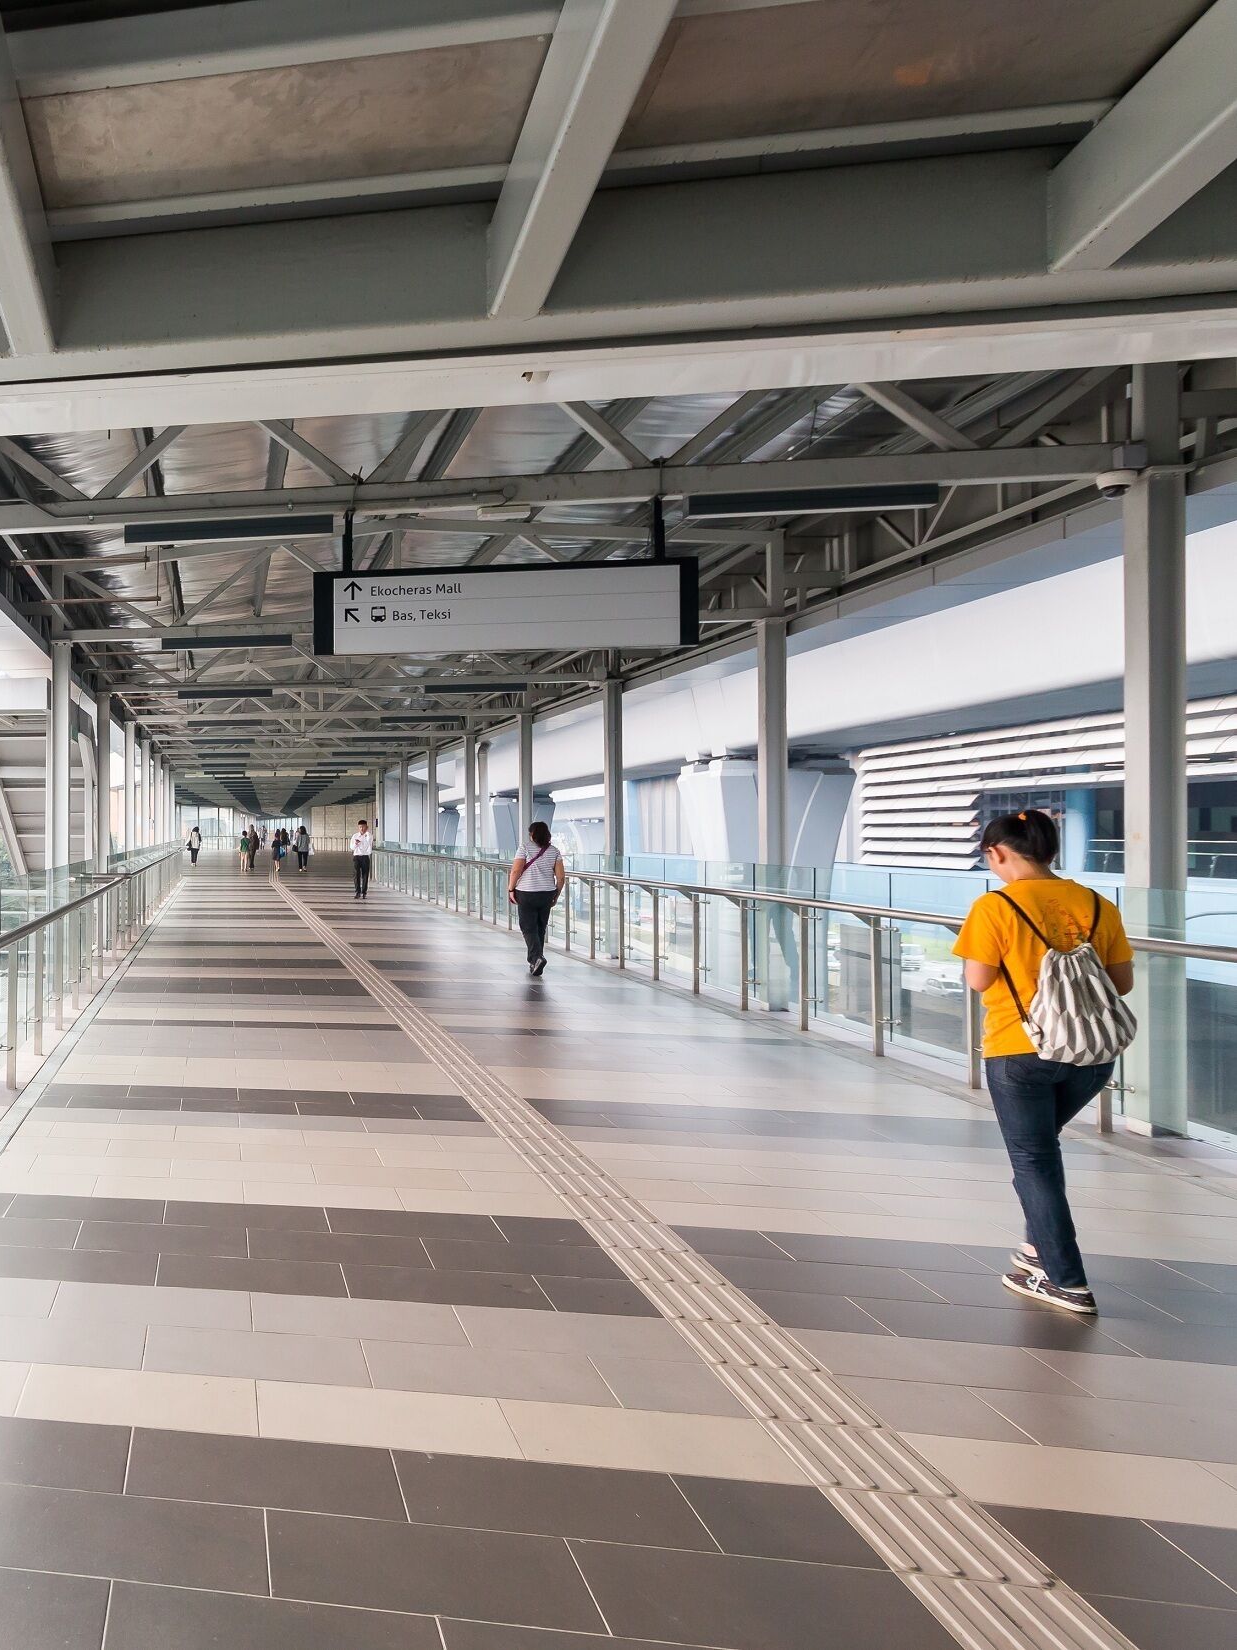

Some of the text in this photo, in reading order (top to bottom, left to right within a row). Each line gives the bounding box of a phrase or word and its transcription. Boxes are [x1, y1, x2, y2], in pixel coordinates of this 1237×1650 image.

[370, 582, 463, 597] Ekocheras Mall
[392, 608, 451, 622] Bas, Teksi
